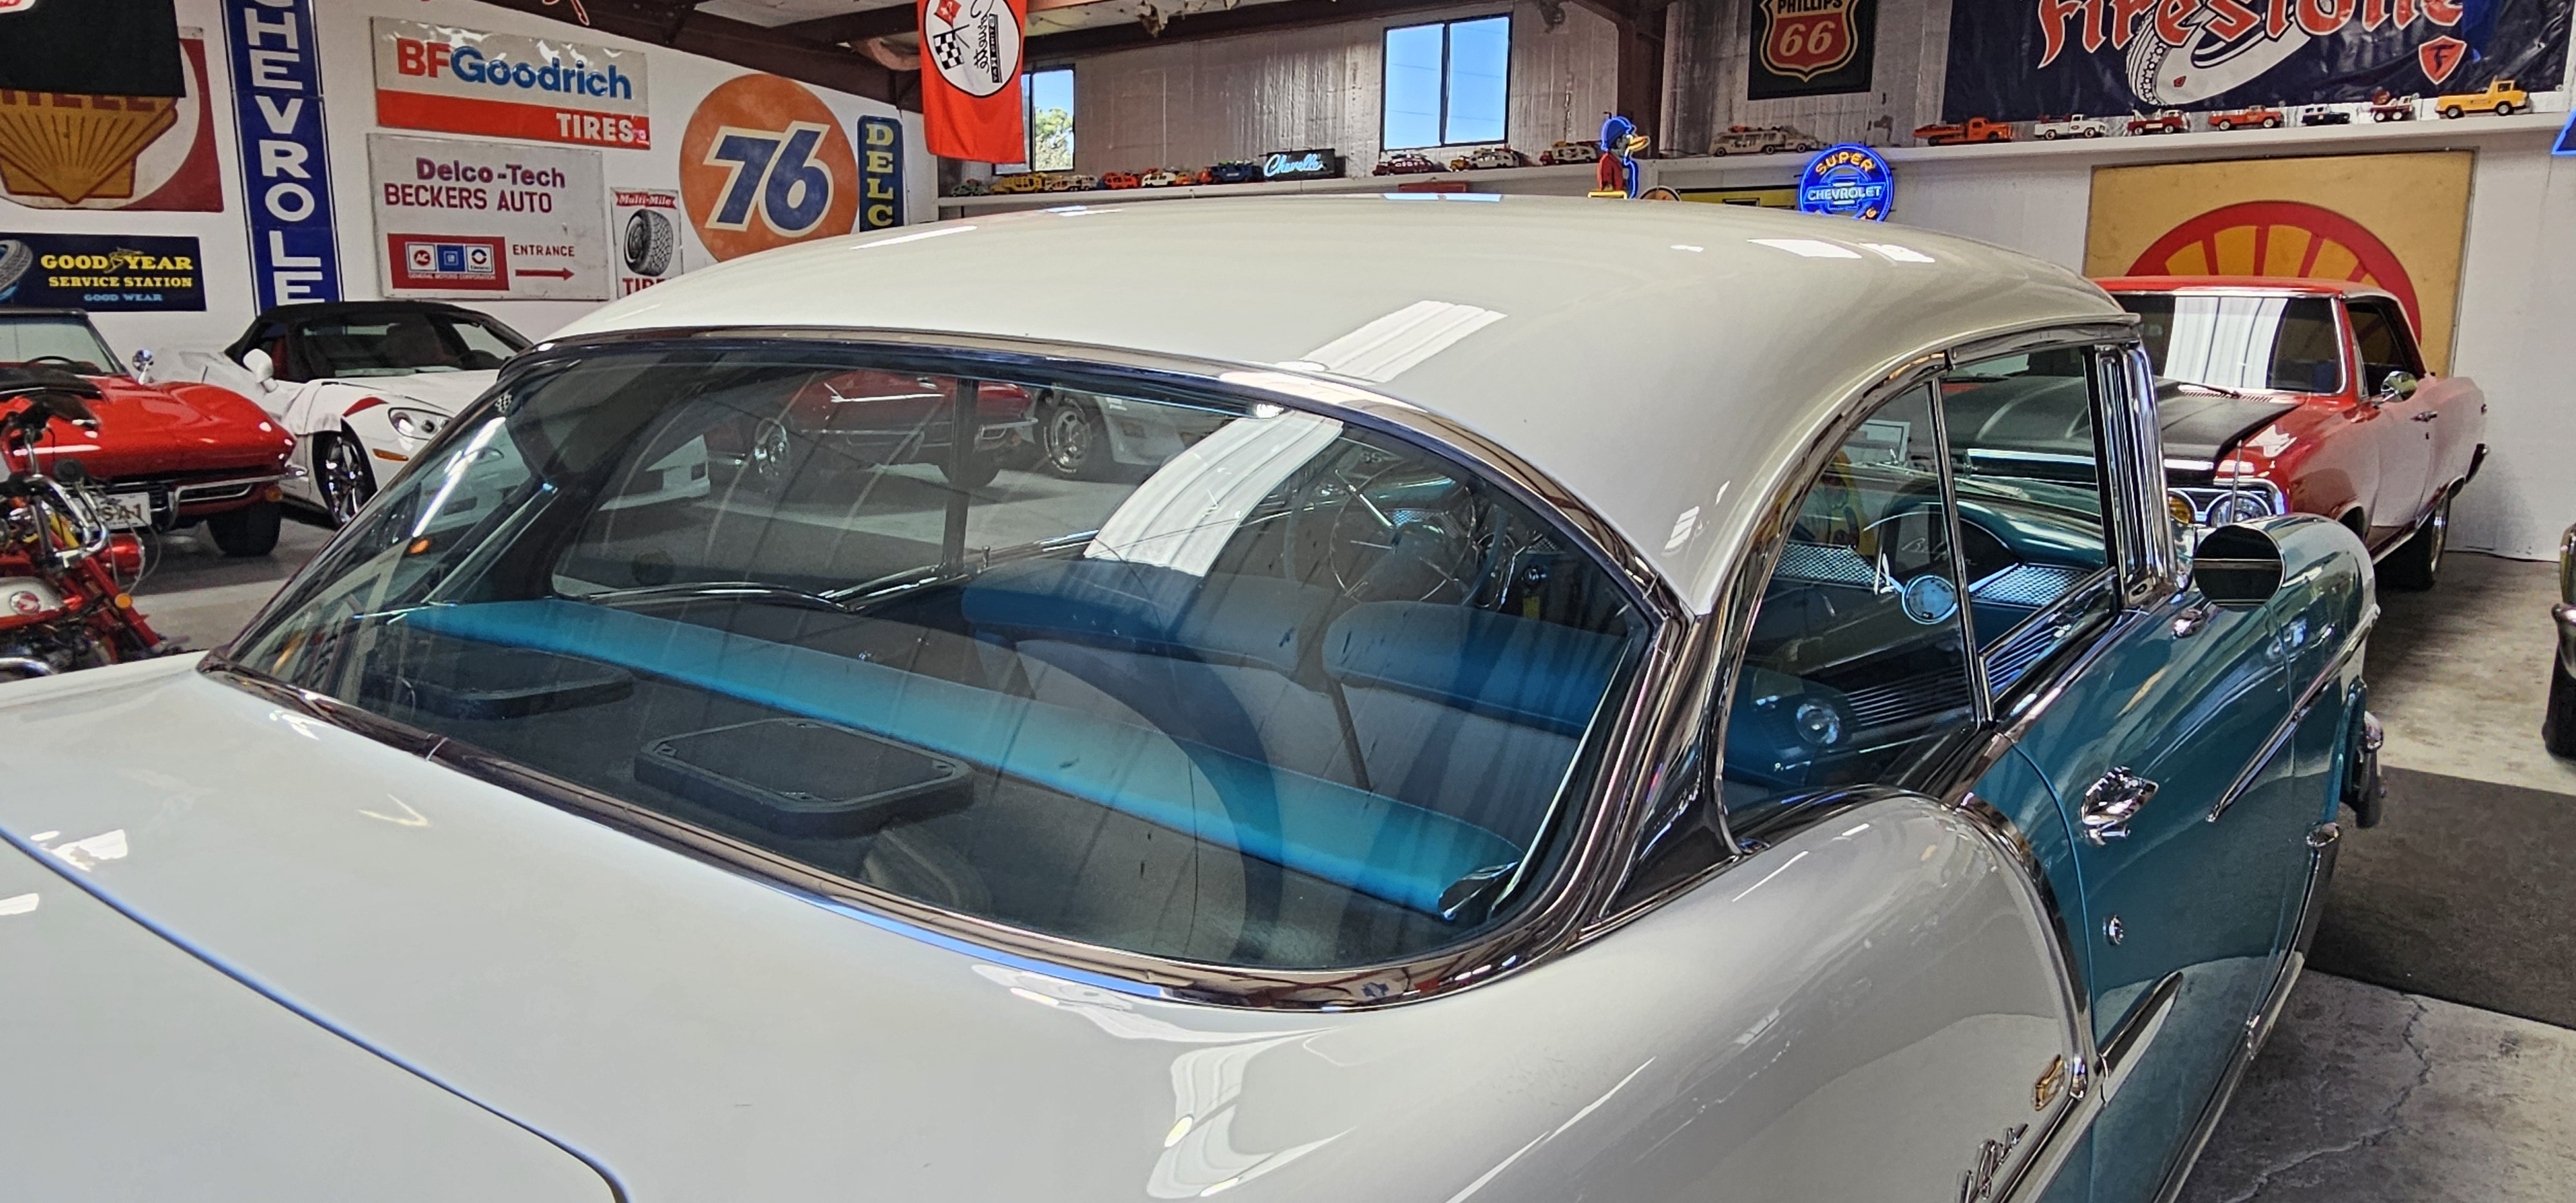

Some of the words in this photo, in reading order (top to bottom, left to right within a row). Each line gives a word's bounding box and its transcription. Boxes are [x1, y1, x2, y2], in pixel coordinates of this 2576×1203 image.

[1779, 21, 1835, 57] 66
[397, 37, 632, 99] BFGoodrich
[556, 113, 634, 143] TIRES
[244, 0, 325, 306] HEVROLE
[1815, 151, 1875, 175] SUPER
[703, 120, 835, 238] 76
[384, 183, 488, 210] BECKERS
[497, 189, 553, 213] AUTO
[1807, 186, 1882, 201] CHEVROLET
[415, 253, 429, 263] AC
[513, 244, 575, 257] ENTRANCE
[48, 276, 119, 287] SERVICE
[124, 277, 193, 287] STATION
[84, 294, 119, 302] GOOD
[122, 294, 163, 302] WEAR
